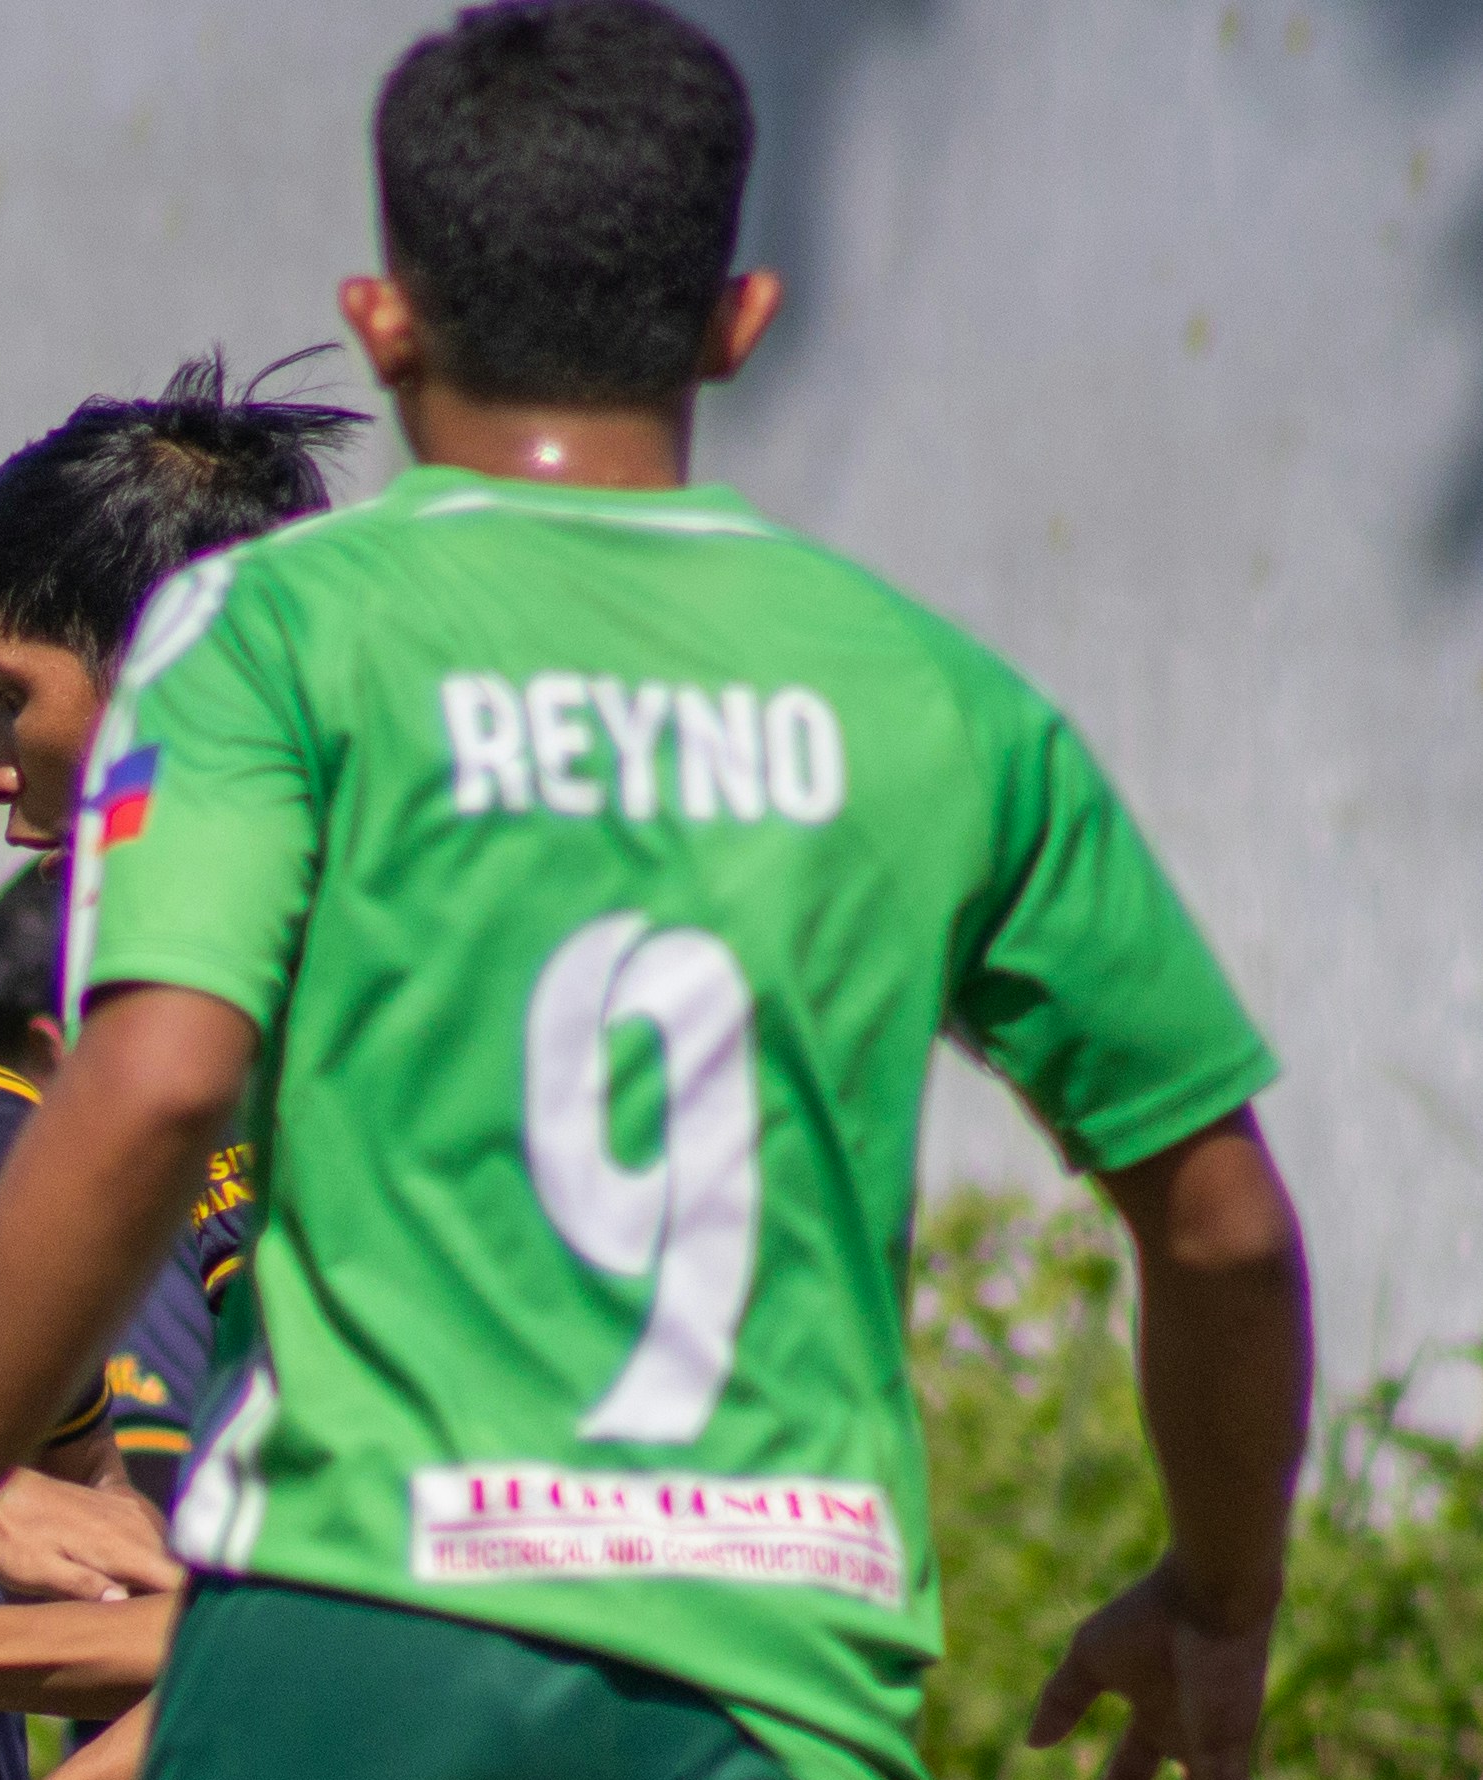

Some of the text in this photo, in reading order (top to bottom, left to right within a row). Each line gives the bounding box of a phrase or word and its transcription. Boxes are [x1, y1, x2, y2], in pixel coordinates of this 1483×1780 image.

[441, 669, 846, 825] REYNO
[524, 909, 761, 1443] 9
[602, 1536, 653, 1566] AND
